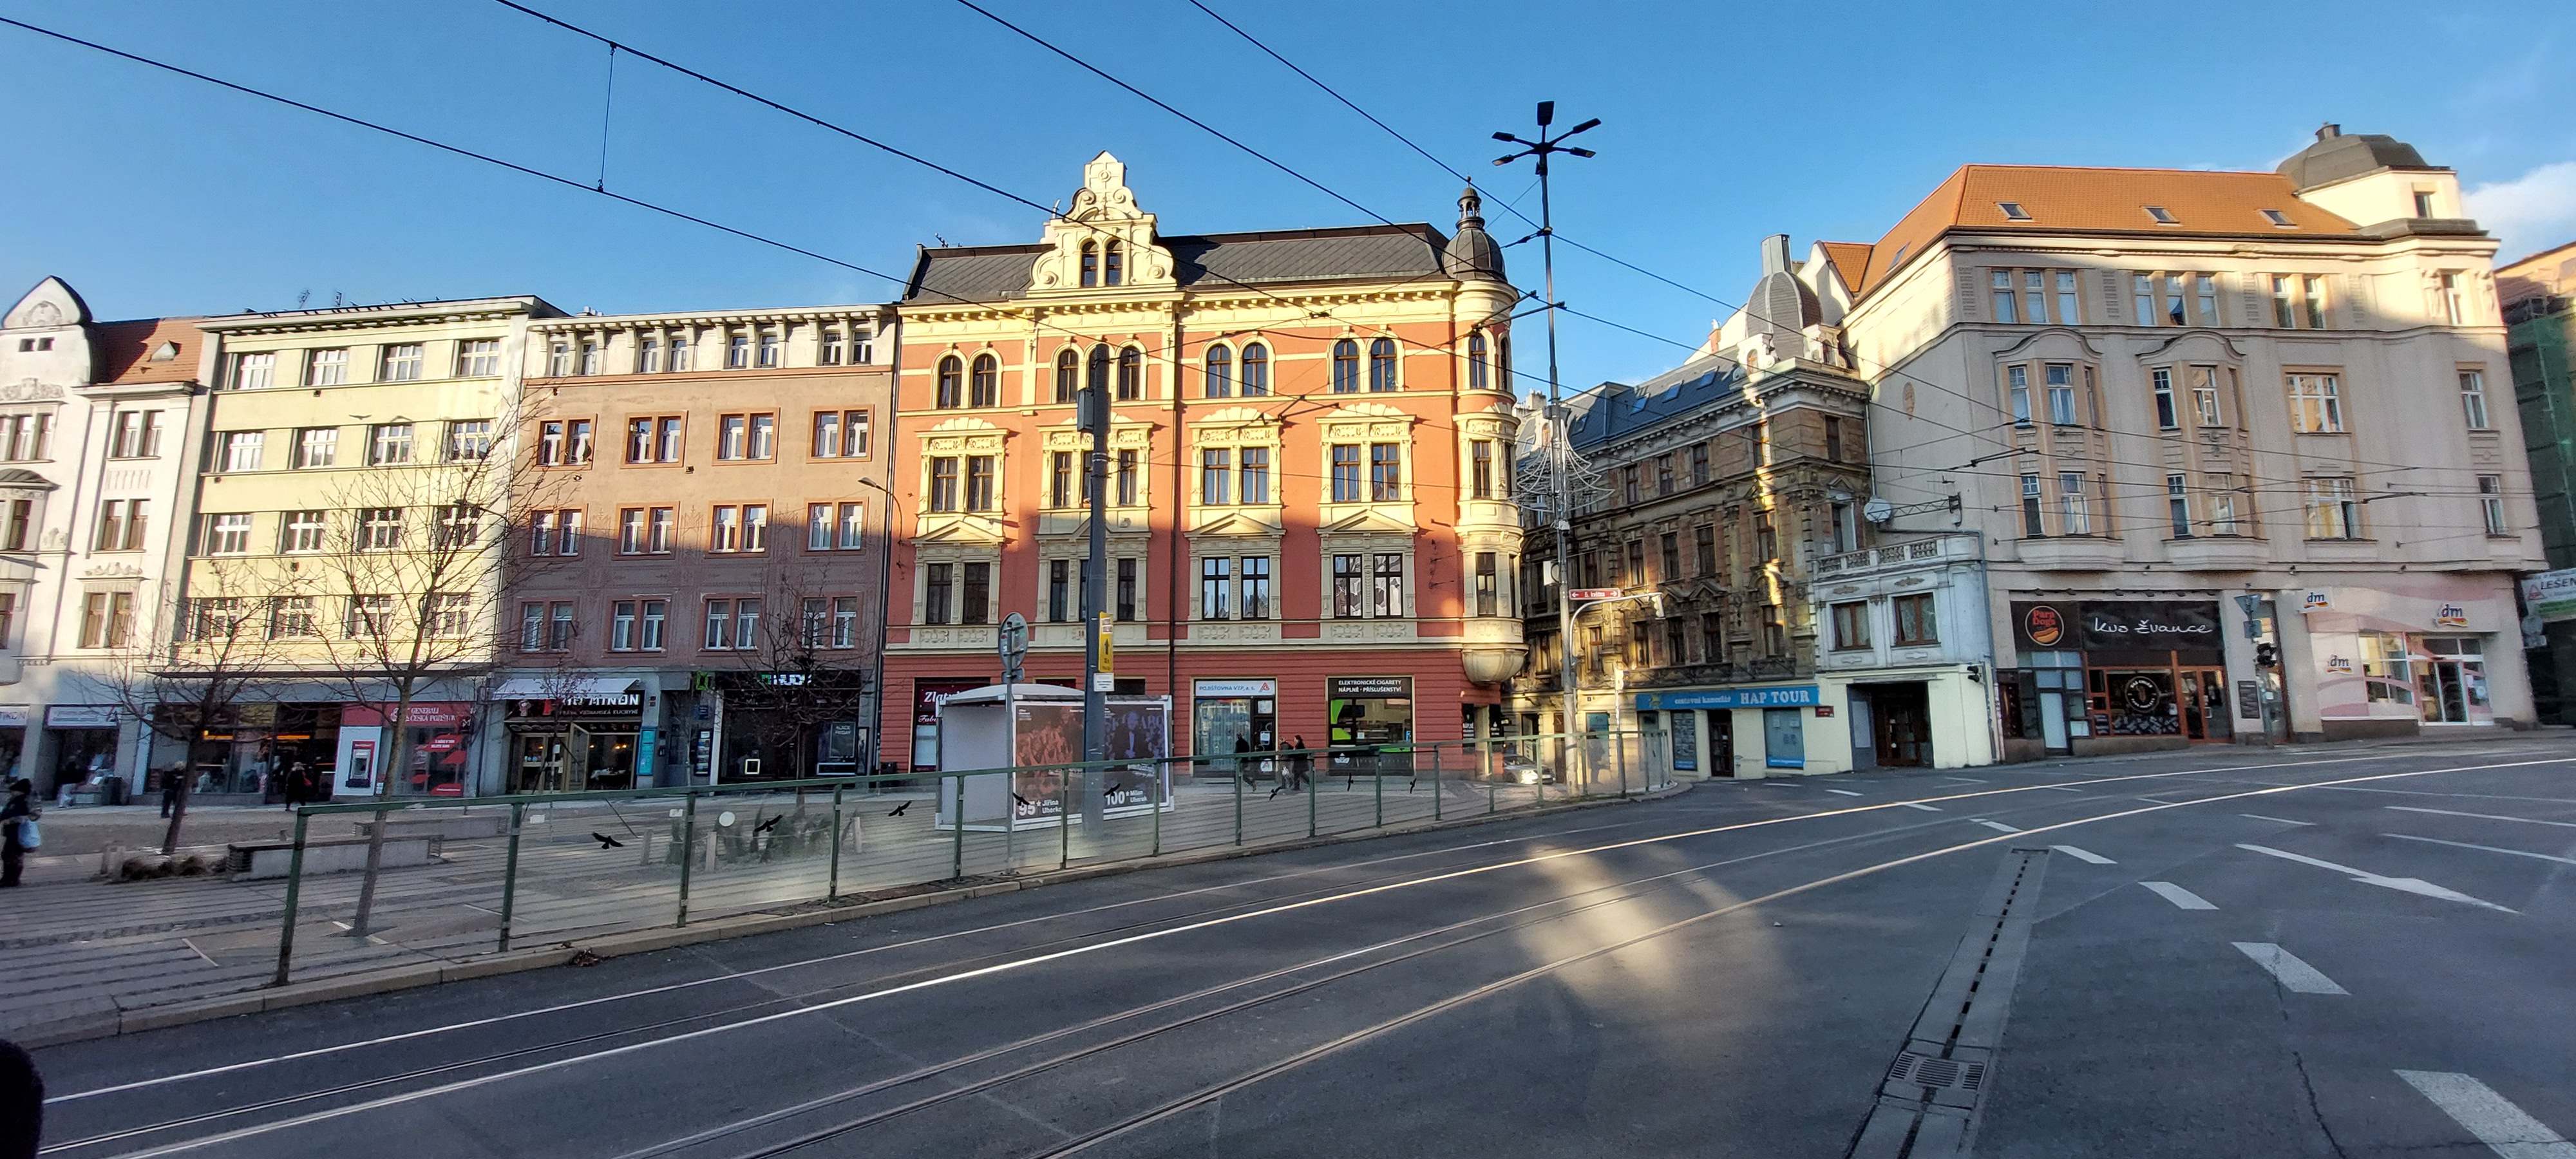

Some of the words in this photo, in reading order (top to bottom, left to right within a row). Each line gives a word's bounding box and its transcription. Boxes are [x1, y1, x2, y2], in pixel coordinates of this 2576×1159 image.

[2307, 592, 2325, 603] dm
[2032, 610, 2056, 618] Para
[2441, 604, 2463, 617] dm
[2032, 617, 2056, 627] Dogs
[2134, 619, 2213, 634] Žvance
[2329, 654, 2349, 667] dm
[1740, 692, 1767, 704] HAP
[1770, 690, 1810, 704] TOUR
[410, 713, 428, 722] ČESKÁ
[1105, 791, 1125, 806] 100
[1018, 800, 1036, 816] 95
